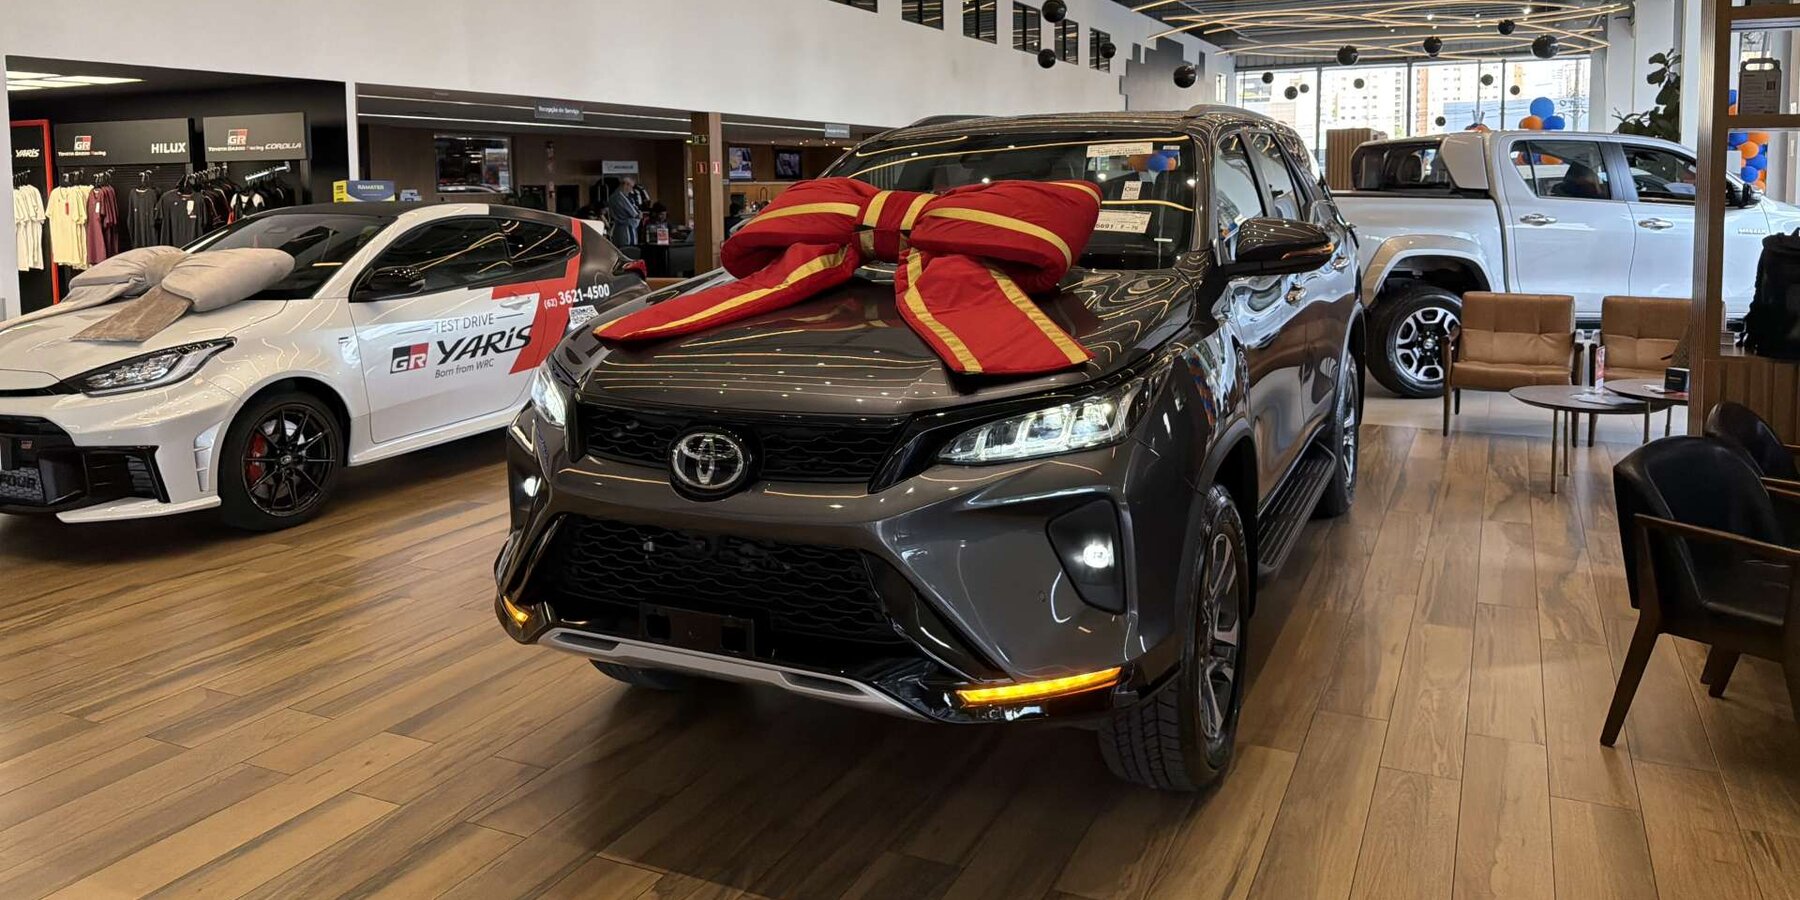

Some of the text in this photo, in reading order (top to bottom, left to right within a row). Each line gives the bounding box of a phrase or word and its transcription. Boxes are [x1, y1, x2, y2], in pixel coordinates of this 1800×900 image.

[151, 142, 186, 154] HILUX
[265, 142, 302, 150] COROLLA
[543, 283, 610, 310] (62) 3621-4500
[434, 313, 494, 334] TEST DRIVE
[390, 351, 427, 374] GR
[435, 358, 495, 379] Born from WRC
